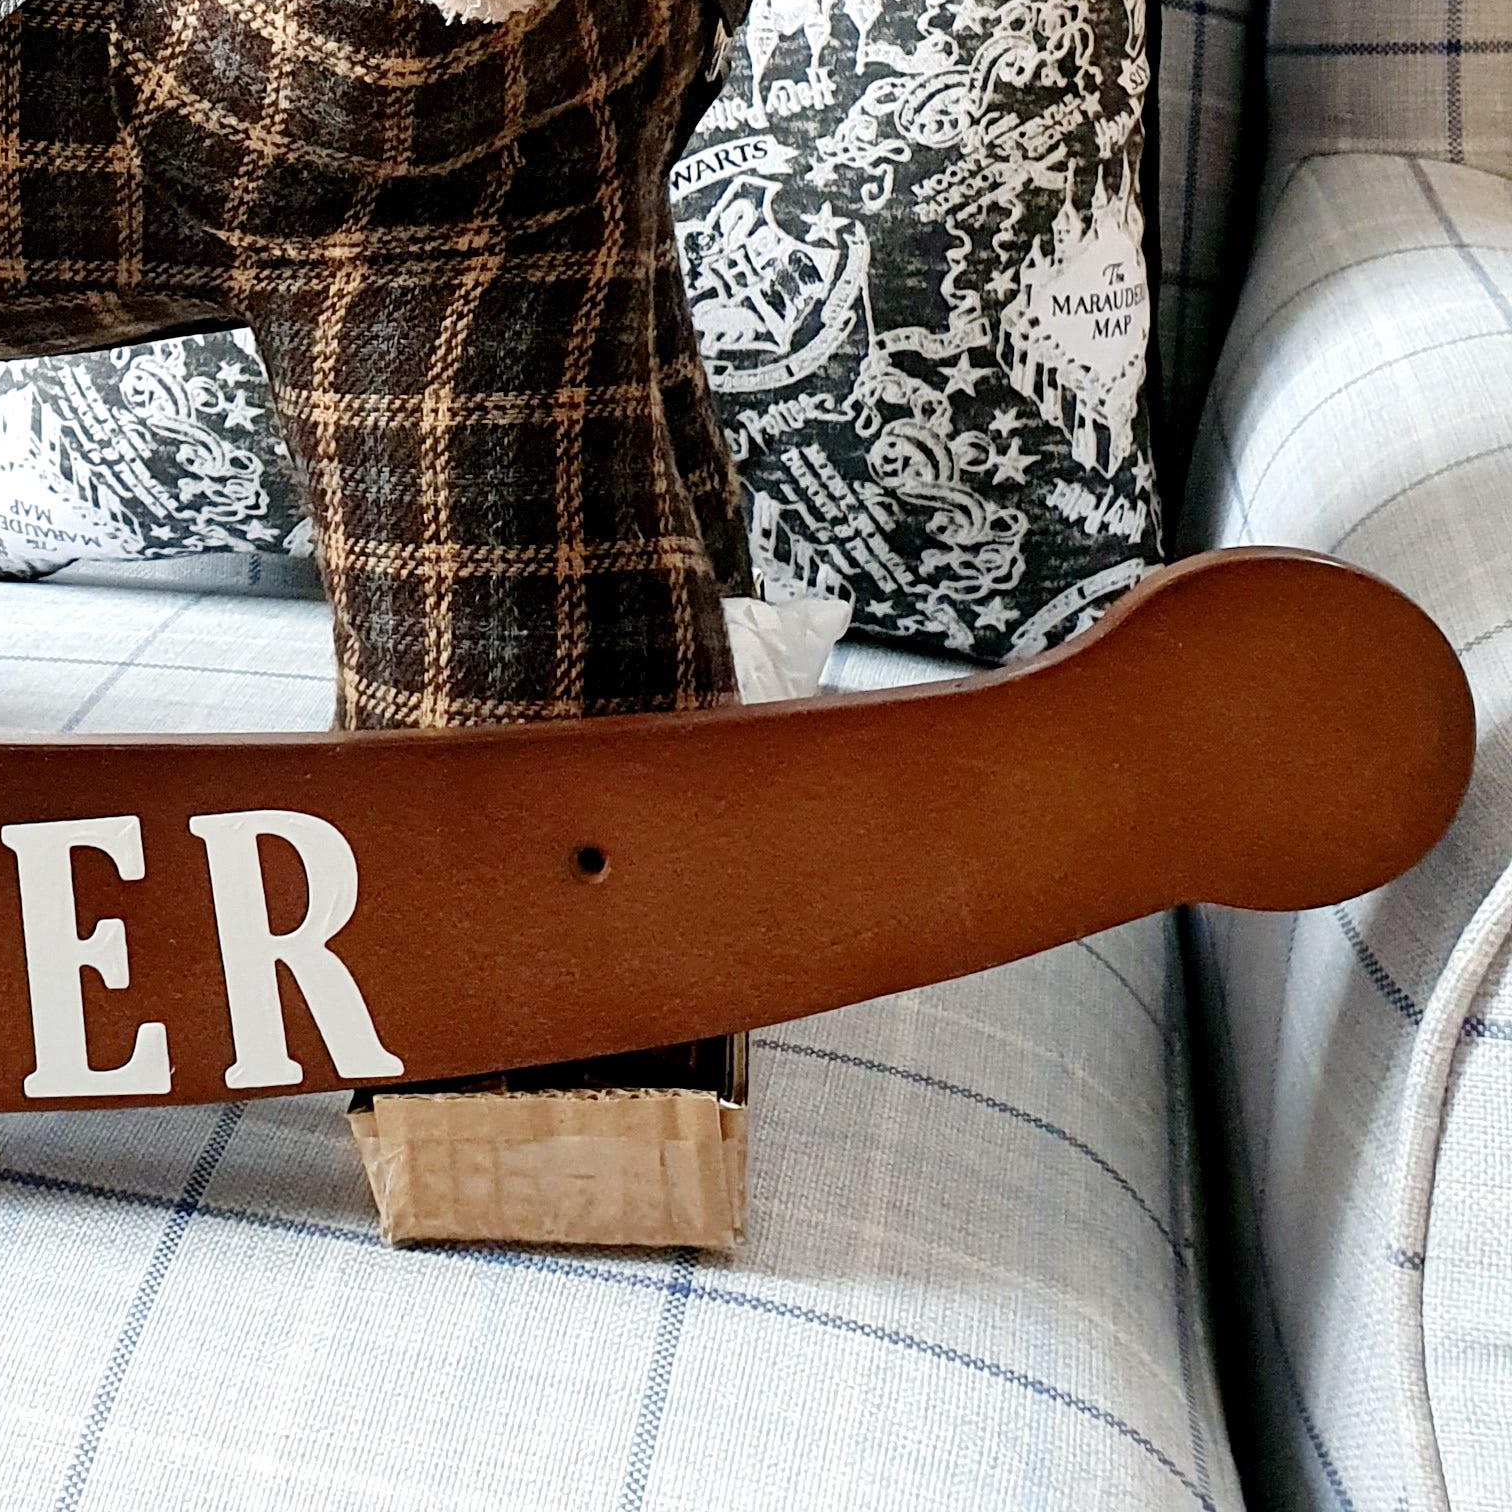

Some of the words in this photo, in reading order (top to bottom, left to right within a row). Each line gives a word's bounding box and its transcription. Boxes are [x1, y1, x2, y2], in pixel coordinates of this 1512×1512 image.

[1102, 262, 1124, 286] The
[1092, 314, 1131, 340] MAP
[10, 498, 53, 525] MAP
